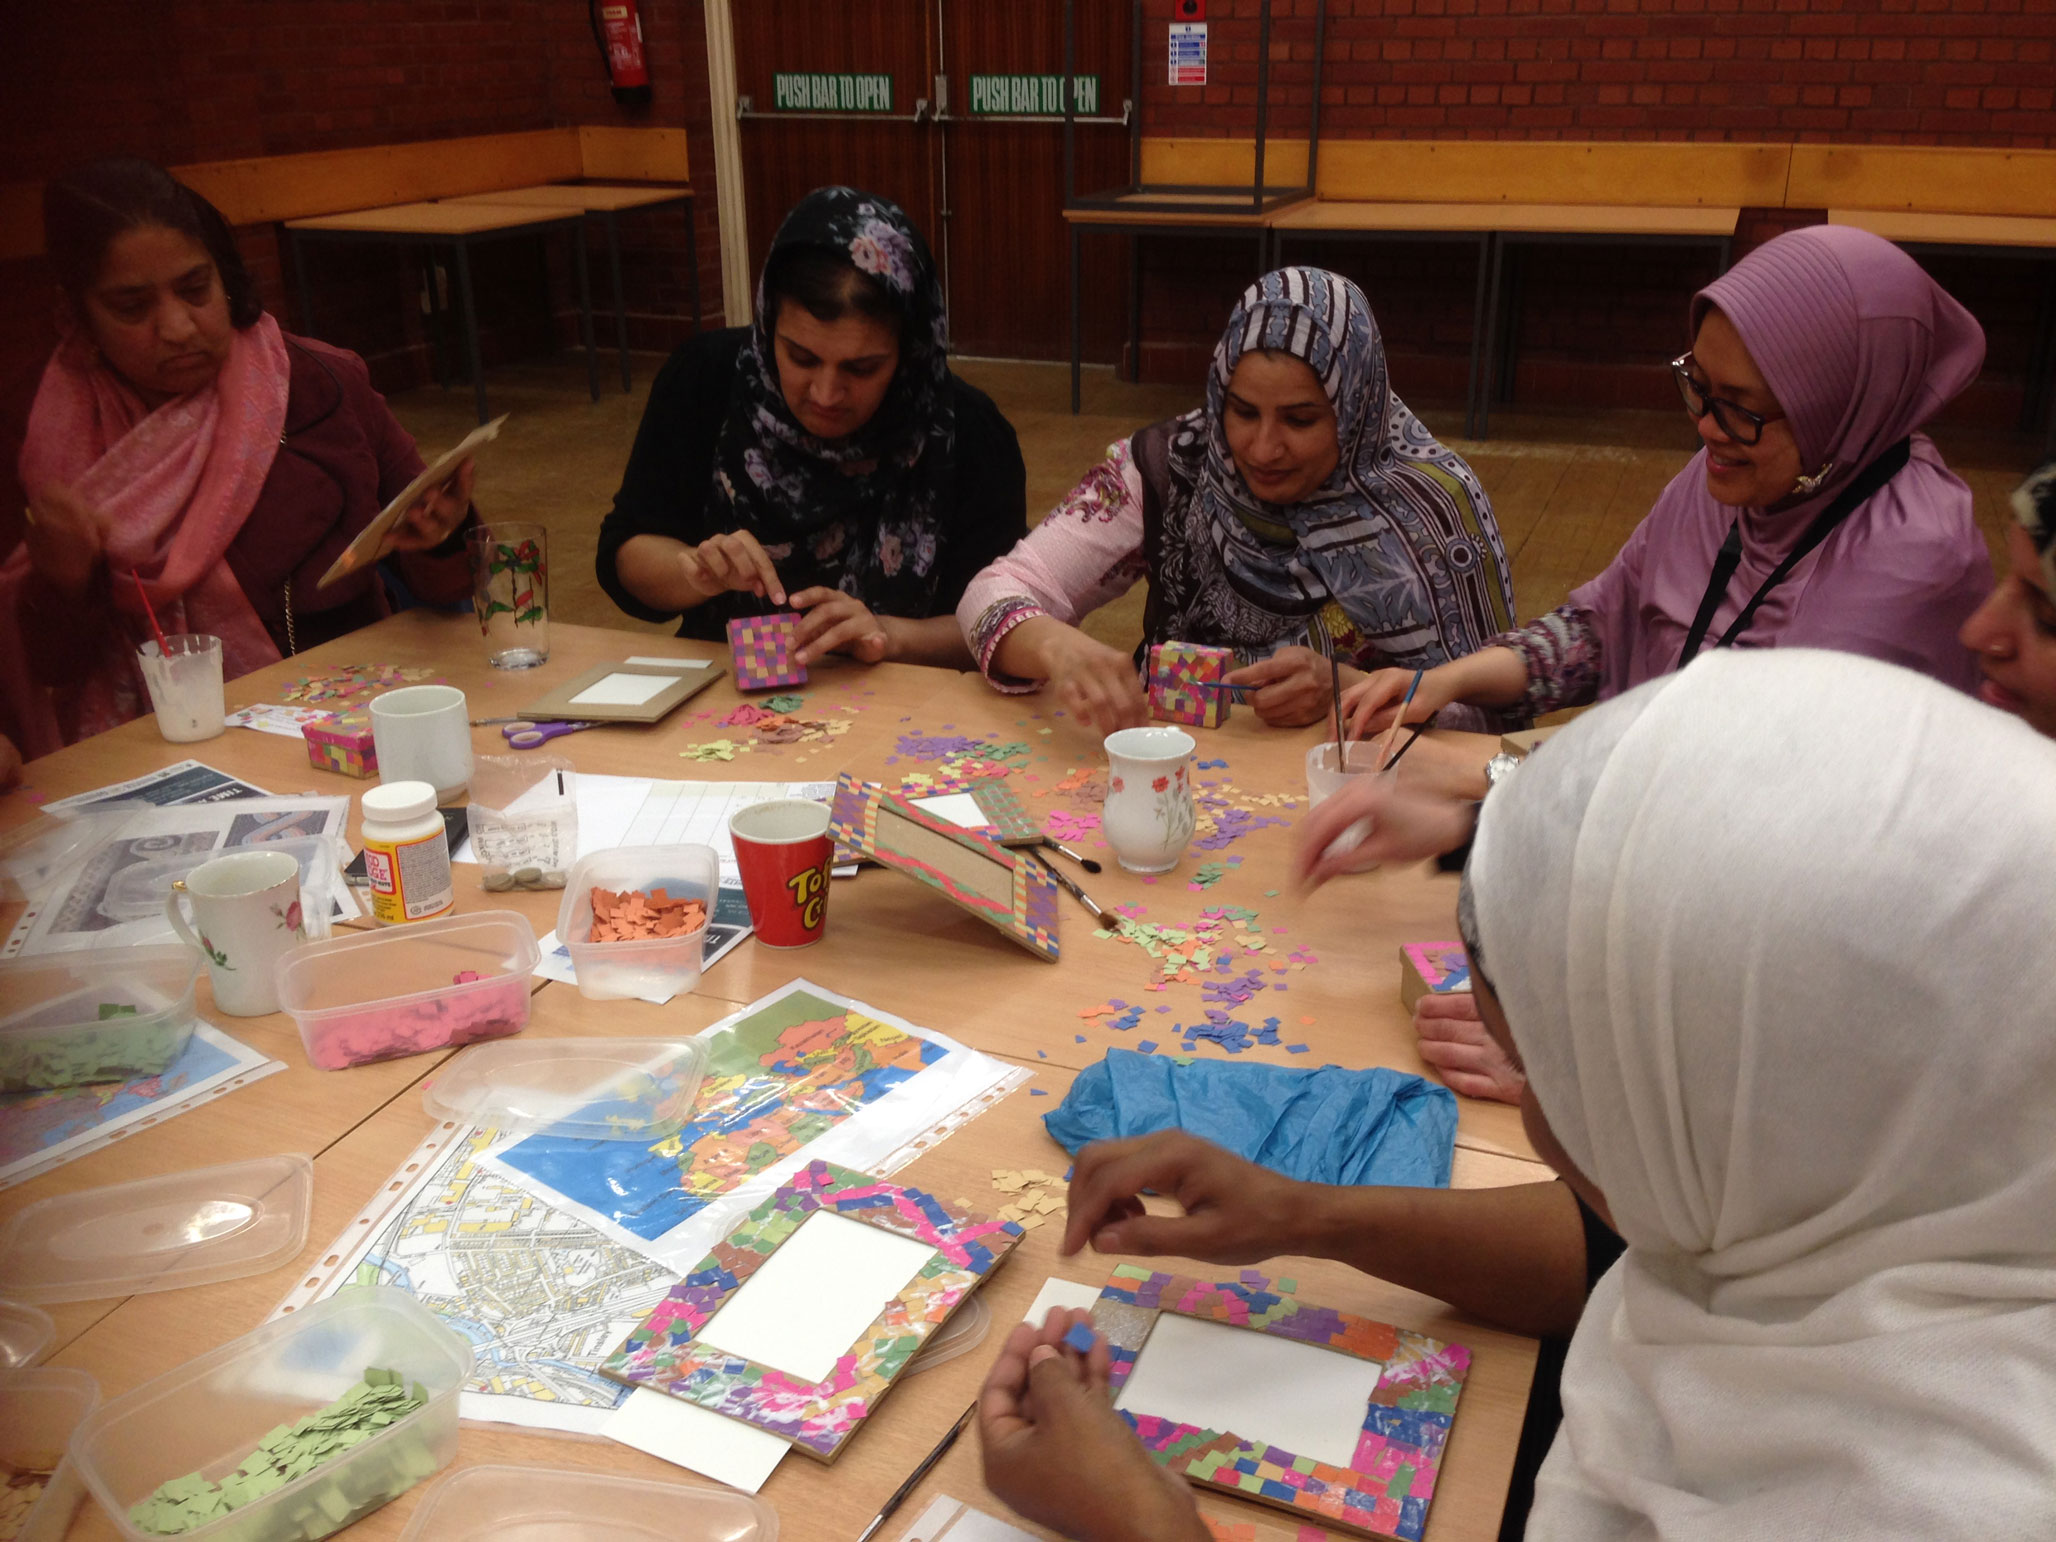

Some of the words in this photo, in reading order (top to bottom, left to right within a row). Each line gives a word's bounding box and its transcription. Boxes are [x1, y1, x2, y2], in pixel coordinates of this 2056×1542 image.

[777, 75, 810, 108] PUSH
[812, 75, 838, 109] BAR
[839, 76, 854, 109] TO
[856, 76, 890, 110] OPEN
[973, 77, 1009, 112] PUSH
[1012, 77, 1039, 112] BAR
[1041, 77, 1057, 112] TO
